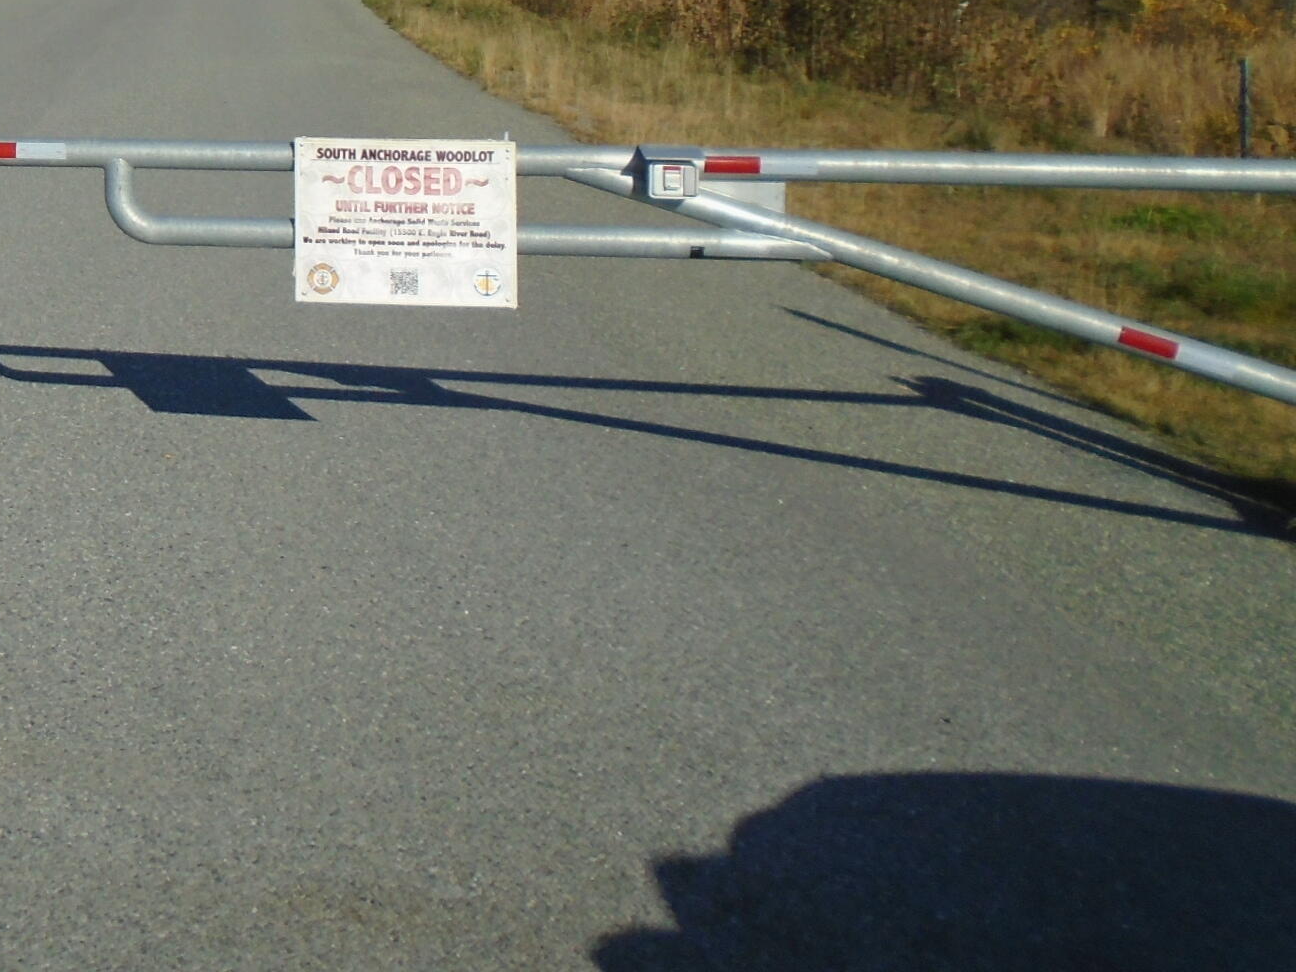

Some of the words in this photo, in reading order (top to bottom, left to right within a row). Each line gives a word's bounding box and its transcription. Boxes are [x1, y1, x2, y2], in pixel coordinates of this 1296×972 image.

[316, 148, 356, 160] SOUTH
[361, 149, 431, 161] ANCHORAGE
[436, 150, 494, 162] WOODLOT
[335, 200, 370, 213] UNTIL
[374, 201, 428, 214] FURTHER
[432, 202, 475, 215] NOTICE
[303, 236, 313, 244] We
[368, 239, 385, 247] open
